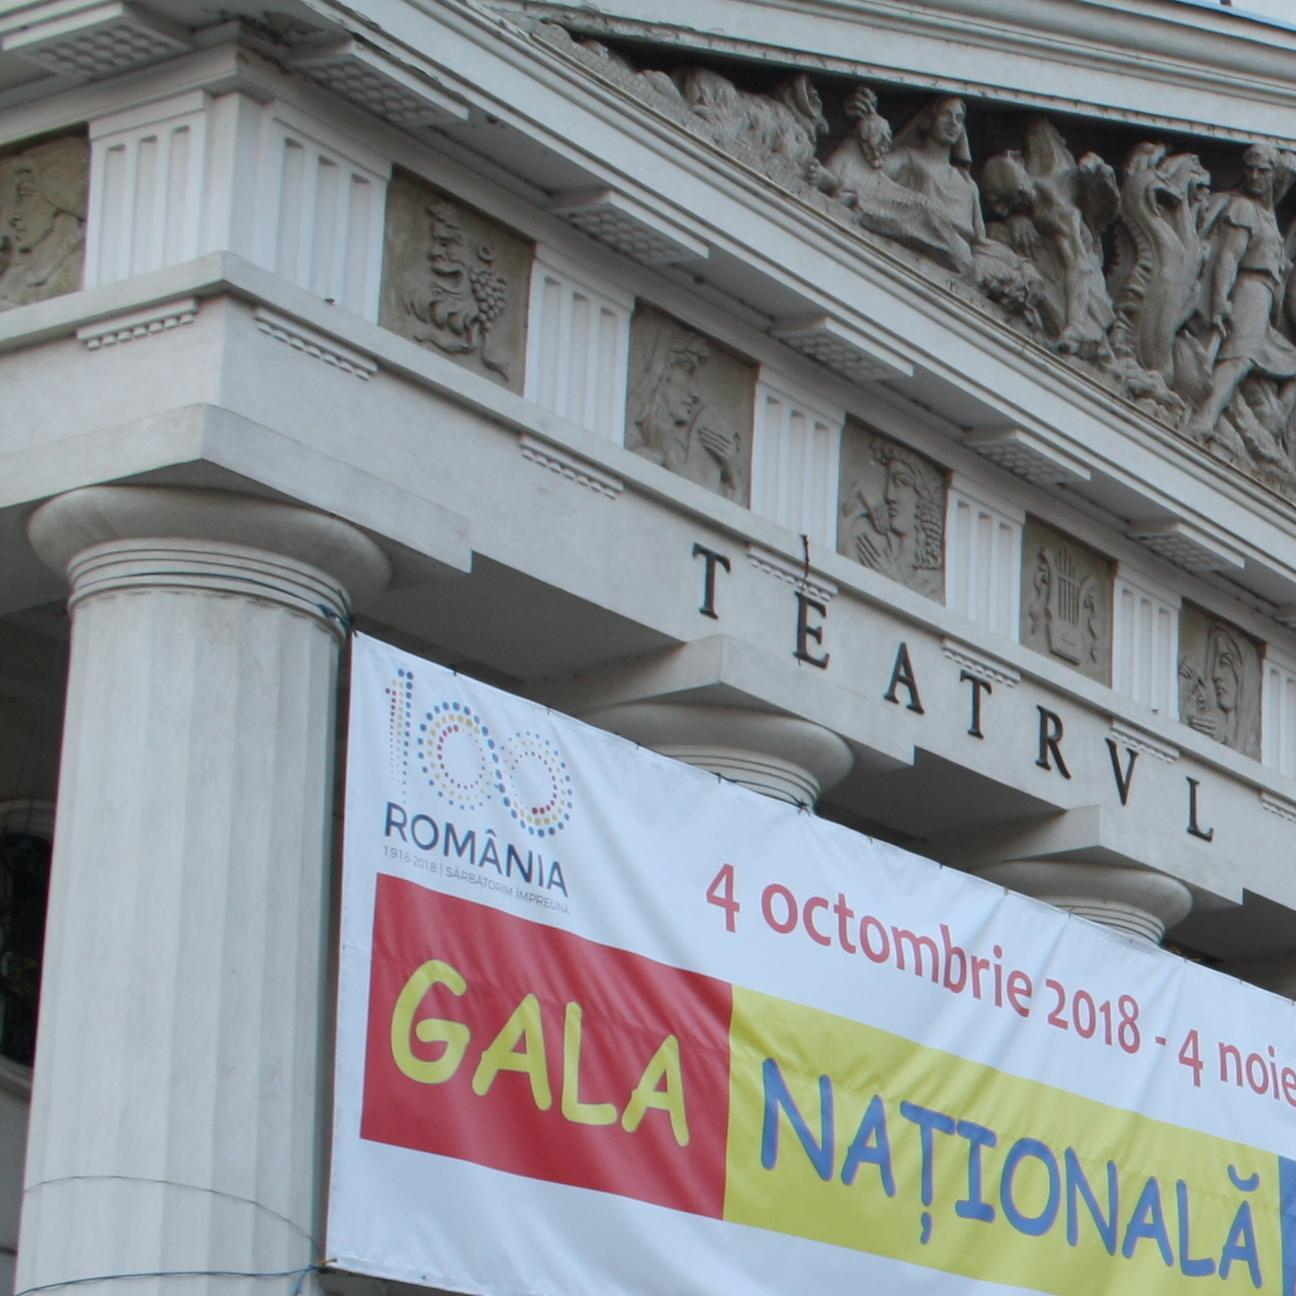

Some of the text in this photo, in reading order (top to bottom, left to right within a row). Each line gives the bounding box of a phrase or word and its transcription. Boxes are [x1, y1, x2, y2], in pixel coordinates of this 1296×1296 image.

[691, 541, 1214, 843] TEATRVL
[384, 800, 570, 899] ROMÂNIA
[706, 863, 741, 933] 4
[760, 883, 1035, 1019] octombrie
[1045, 978, 1141, 1054] 2018
[1178, 1029, 1205, 1087] 4
[390, 958, 691, 1148] GALA
[761, 1056, 1264, 1290] NAȚIONALĂ
